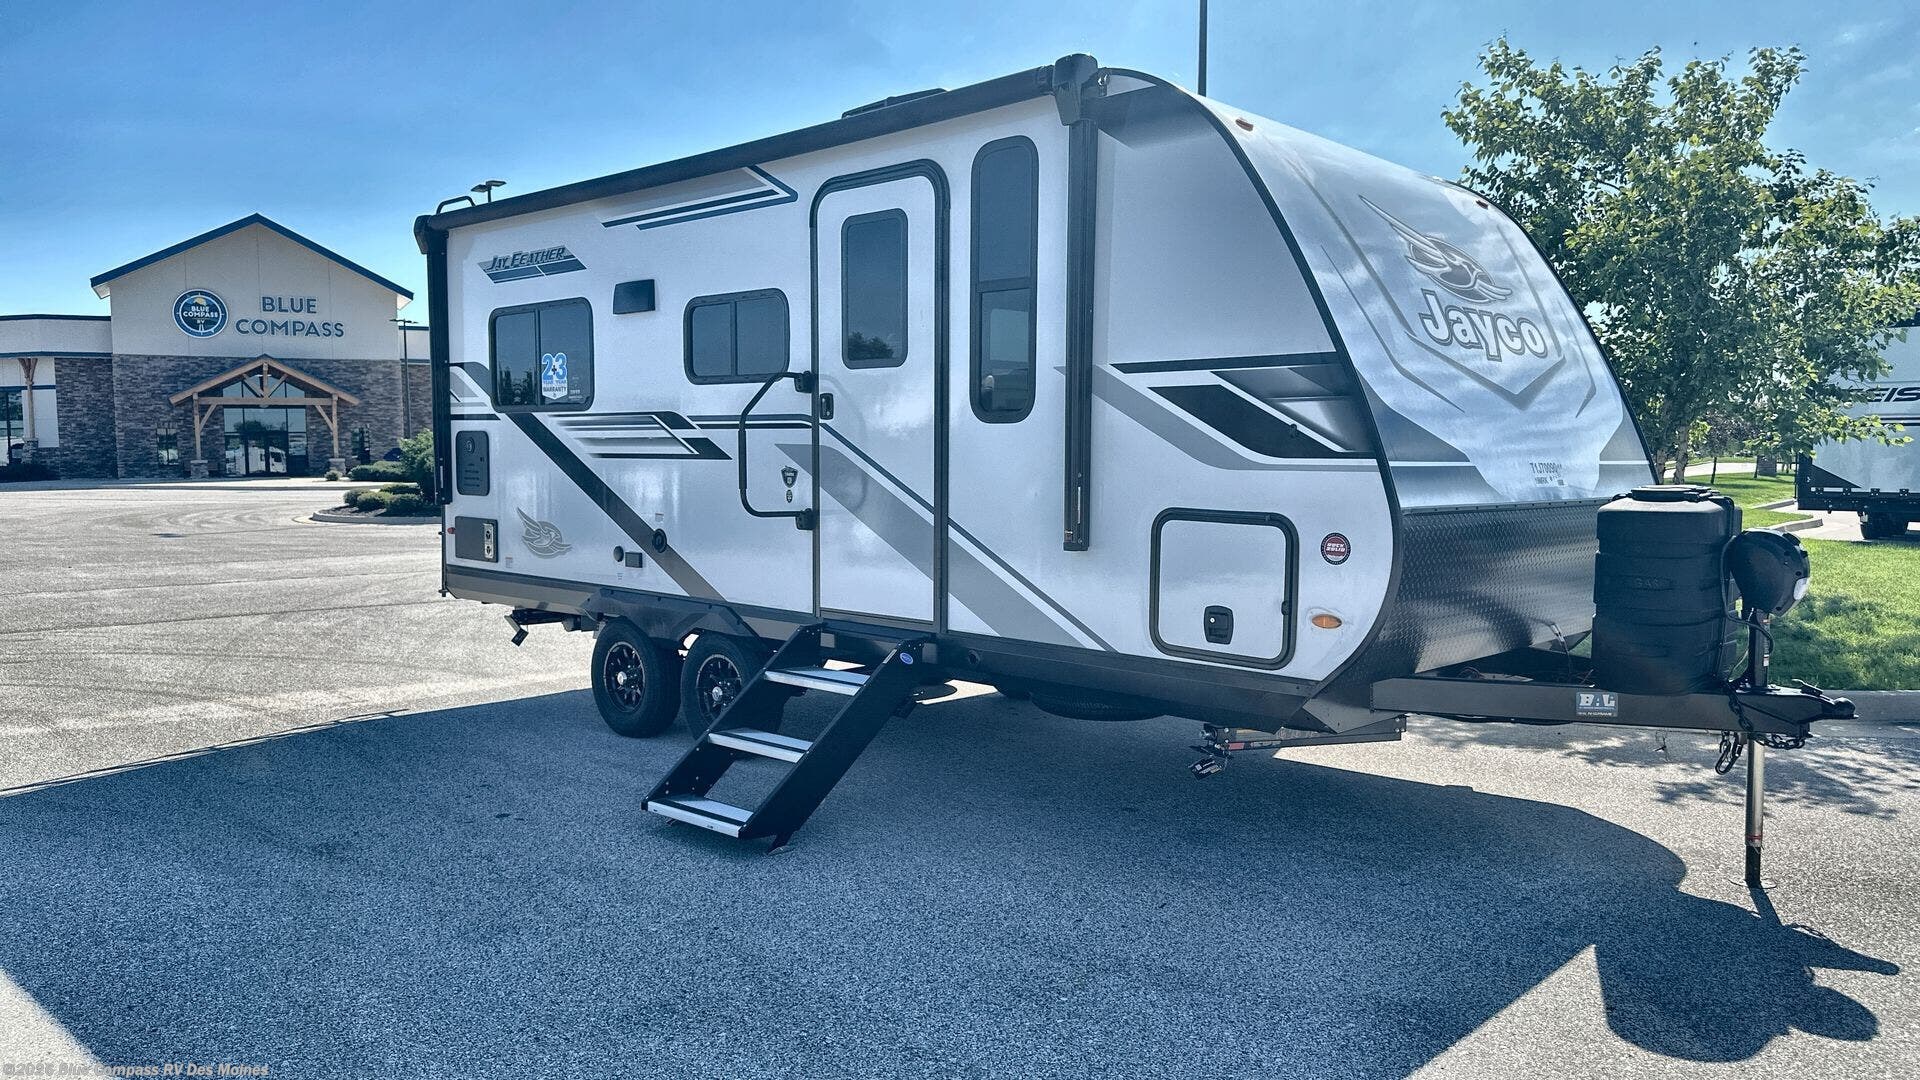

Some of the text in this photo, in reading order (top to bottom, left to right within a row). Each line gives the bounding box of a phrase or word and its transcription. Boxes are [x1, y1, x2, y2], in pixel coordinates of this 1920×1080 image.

[510, 247, 566, 267] FEATHER
[261, 297, 317, 313] BLUE
[235, 318, 344, 337] COMPASS
[1418, 287, 1548, 362] Jayco
[1579, 693, 1615, 706] BAL
